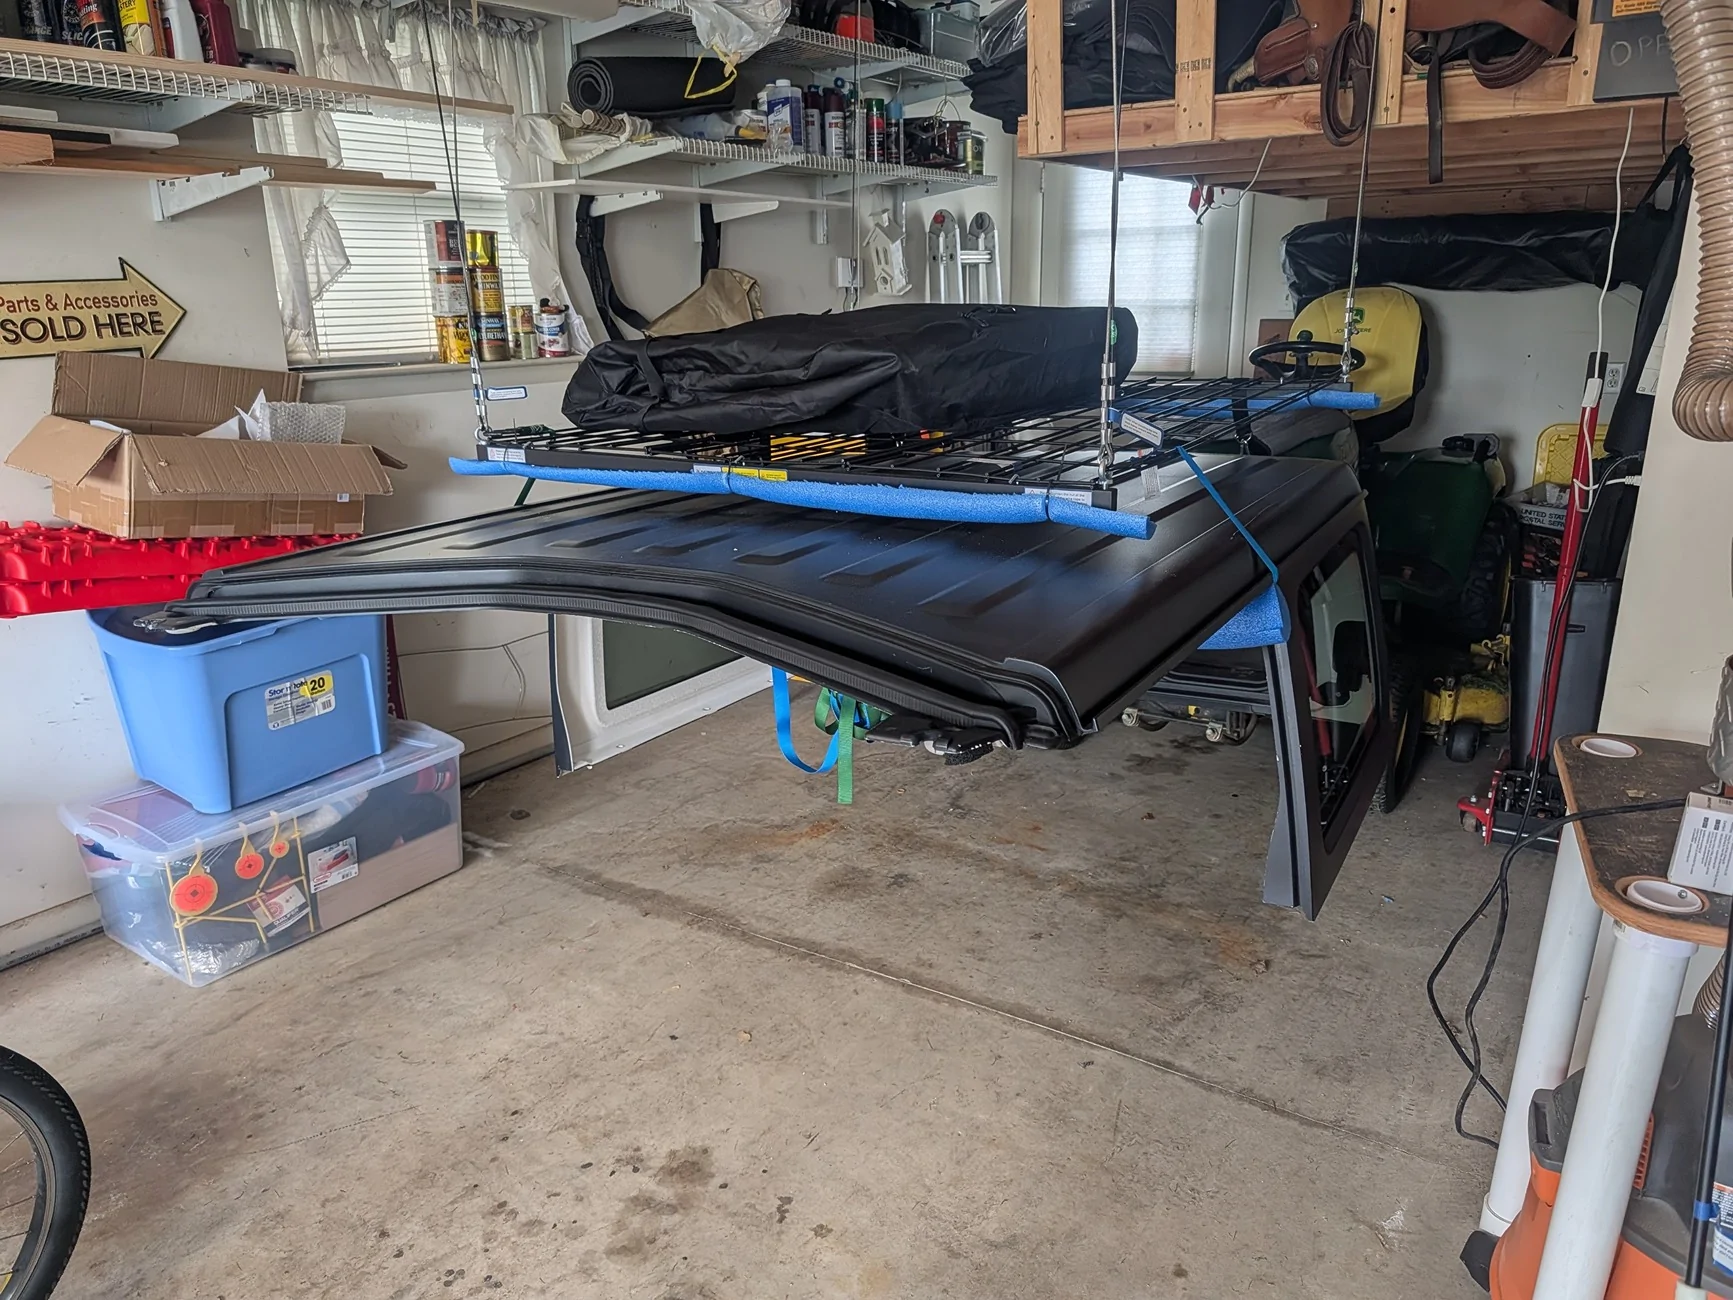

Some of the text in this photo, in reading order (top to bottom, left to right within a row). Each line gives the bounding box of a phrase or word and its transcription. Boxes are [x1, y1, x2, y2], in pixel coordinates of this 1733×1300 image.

[80, 3, 98, 16] ating
[61, 30, 84, 41] SLIC
[1610, 34, 1669, 66] OPE
[45, 293, 59, 311] &
[63, 290, 158, 311] Accessories
[0, 311, 166, 345] SOLD HERE
[1548, 512, 1566, 521] STAT
[309, 677, 325, 692] 20
